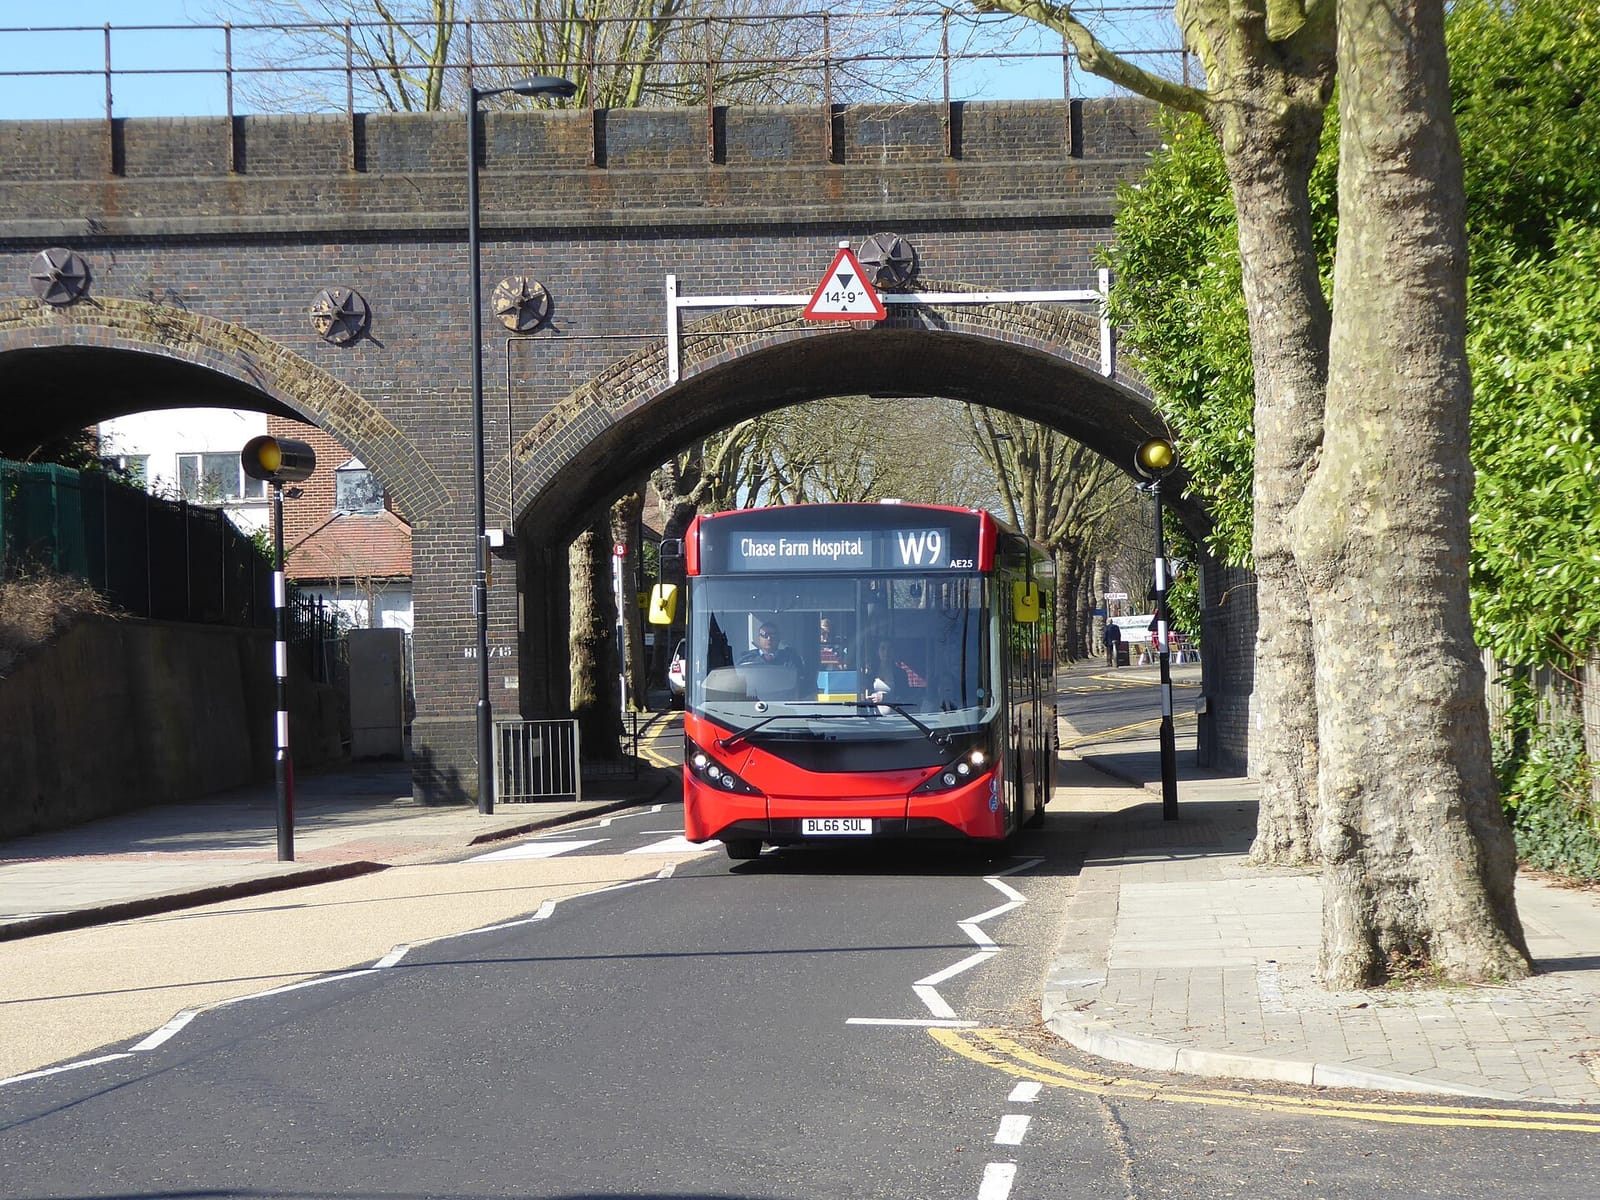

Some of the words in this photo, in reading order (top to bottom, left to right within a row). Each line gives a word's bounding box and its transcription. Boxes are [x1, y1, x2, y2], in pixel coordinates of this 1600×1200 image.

[616, 545, 624, 555] B
[741, 538, 776, 557] Chase
[779, 538, 809, 557] Farm
[812, 537, 864, 560] Hospital
[898, 530, 942, 565] W9
[950, 559, 973, 568] AE25
[808, 820, 839, 831] BL66
[842, 820, 866, 831] SUL
